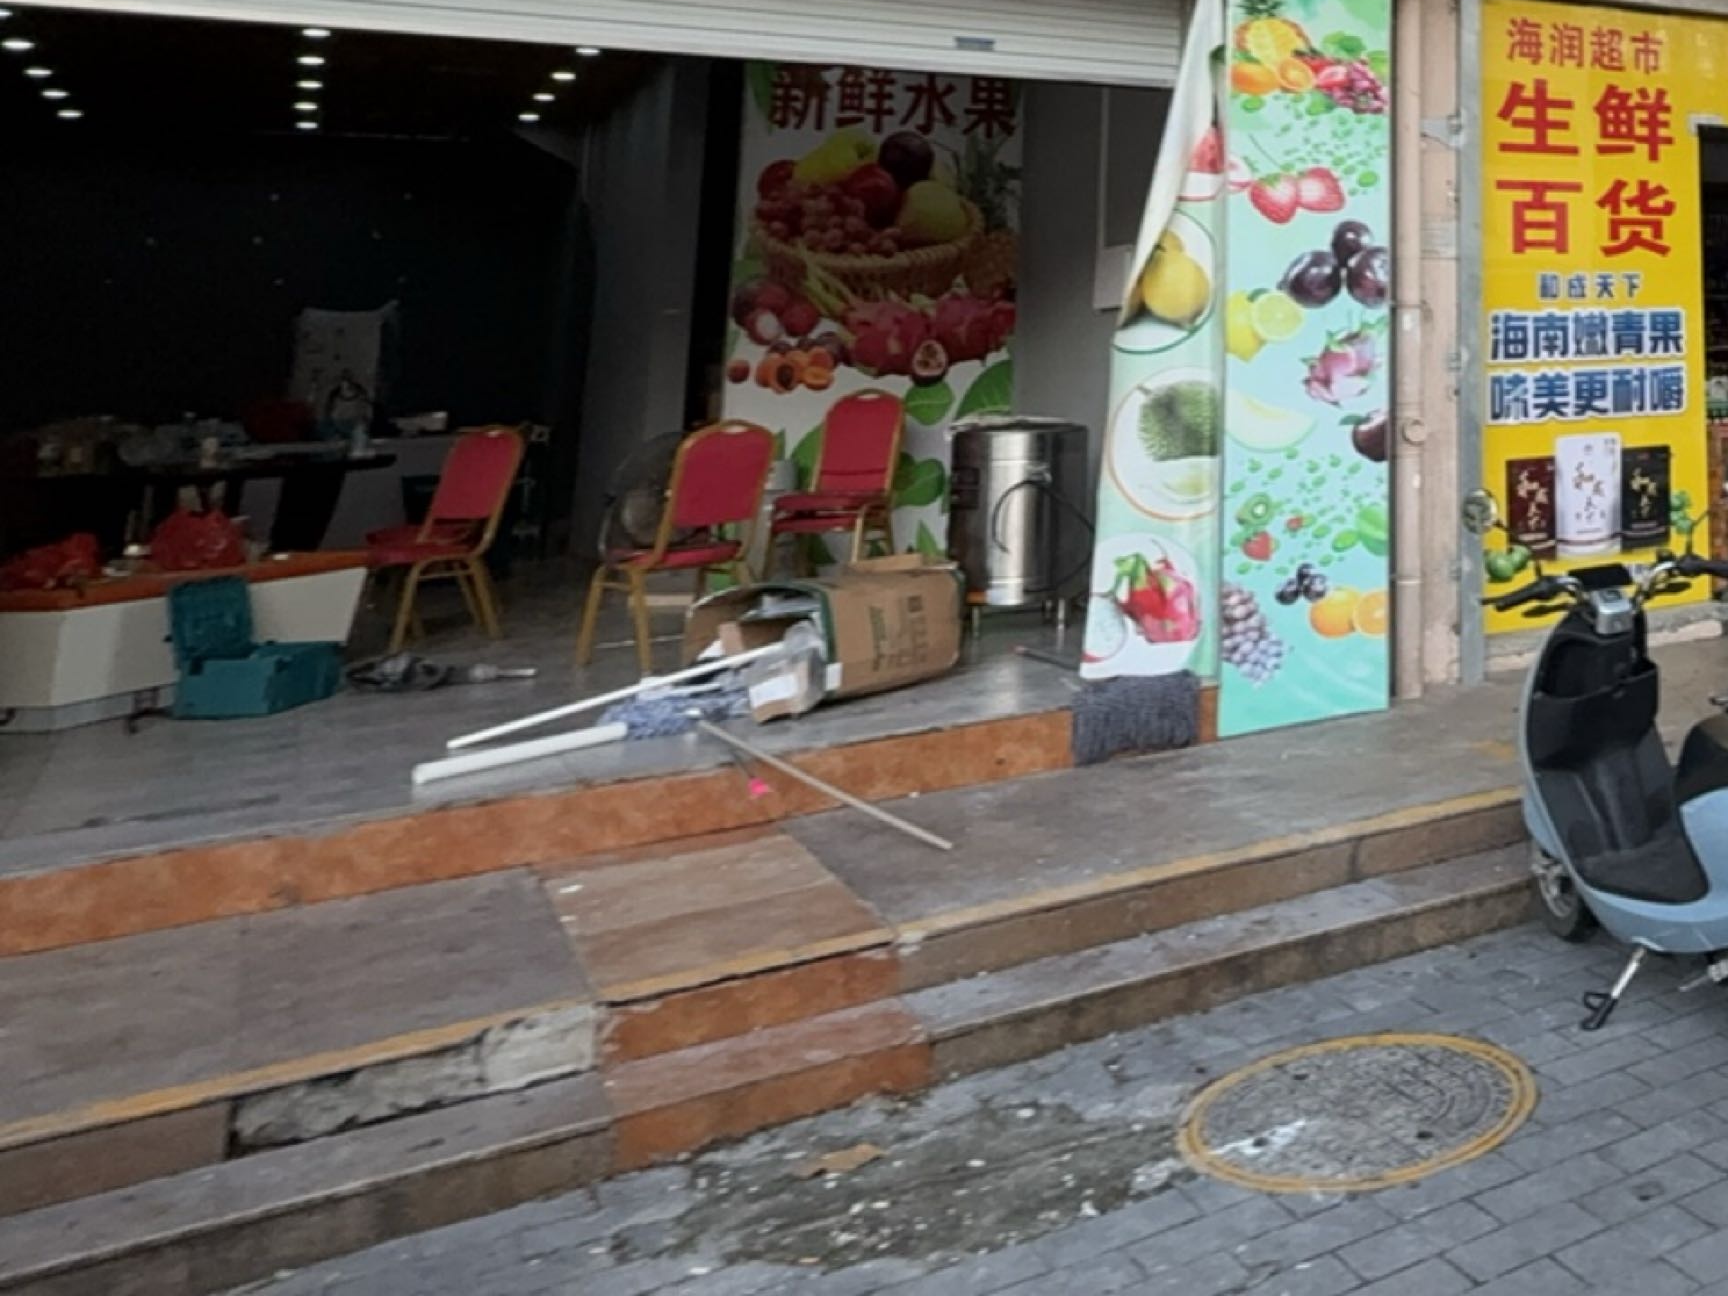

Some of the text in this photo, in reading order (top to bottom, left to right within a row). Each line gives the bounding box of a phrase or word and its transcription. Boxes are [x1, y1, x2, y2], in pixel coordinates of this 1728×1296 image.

[1506, 16, 1664, 75] 海润超市
[766, 62, 1017, 139] 新鲜水果
[1496, 78, 1675, 163] 生鲜
[1496, 178, 1677, 258] 百货
[1539, 272, 1643, 299] 和成天下
[1488, 309, 1684, 361] 海南嫩青果
